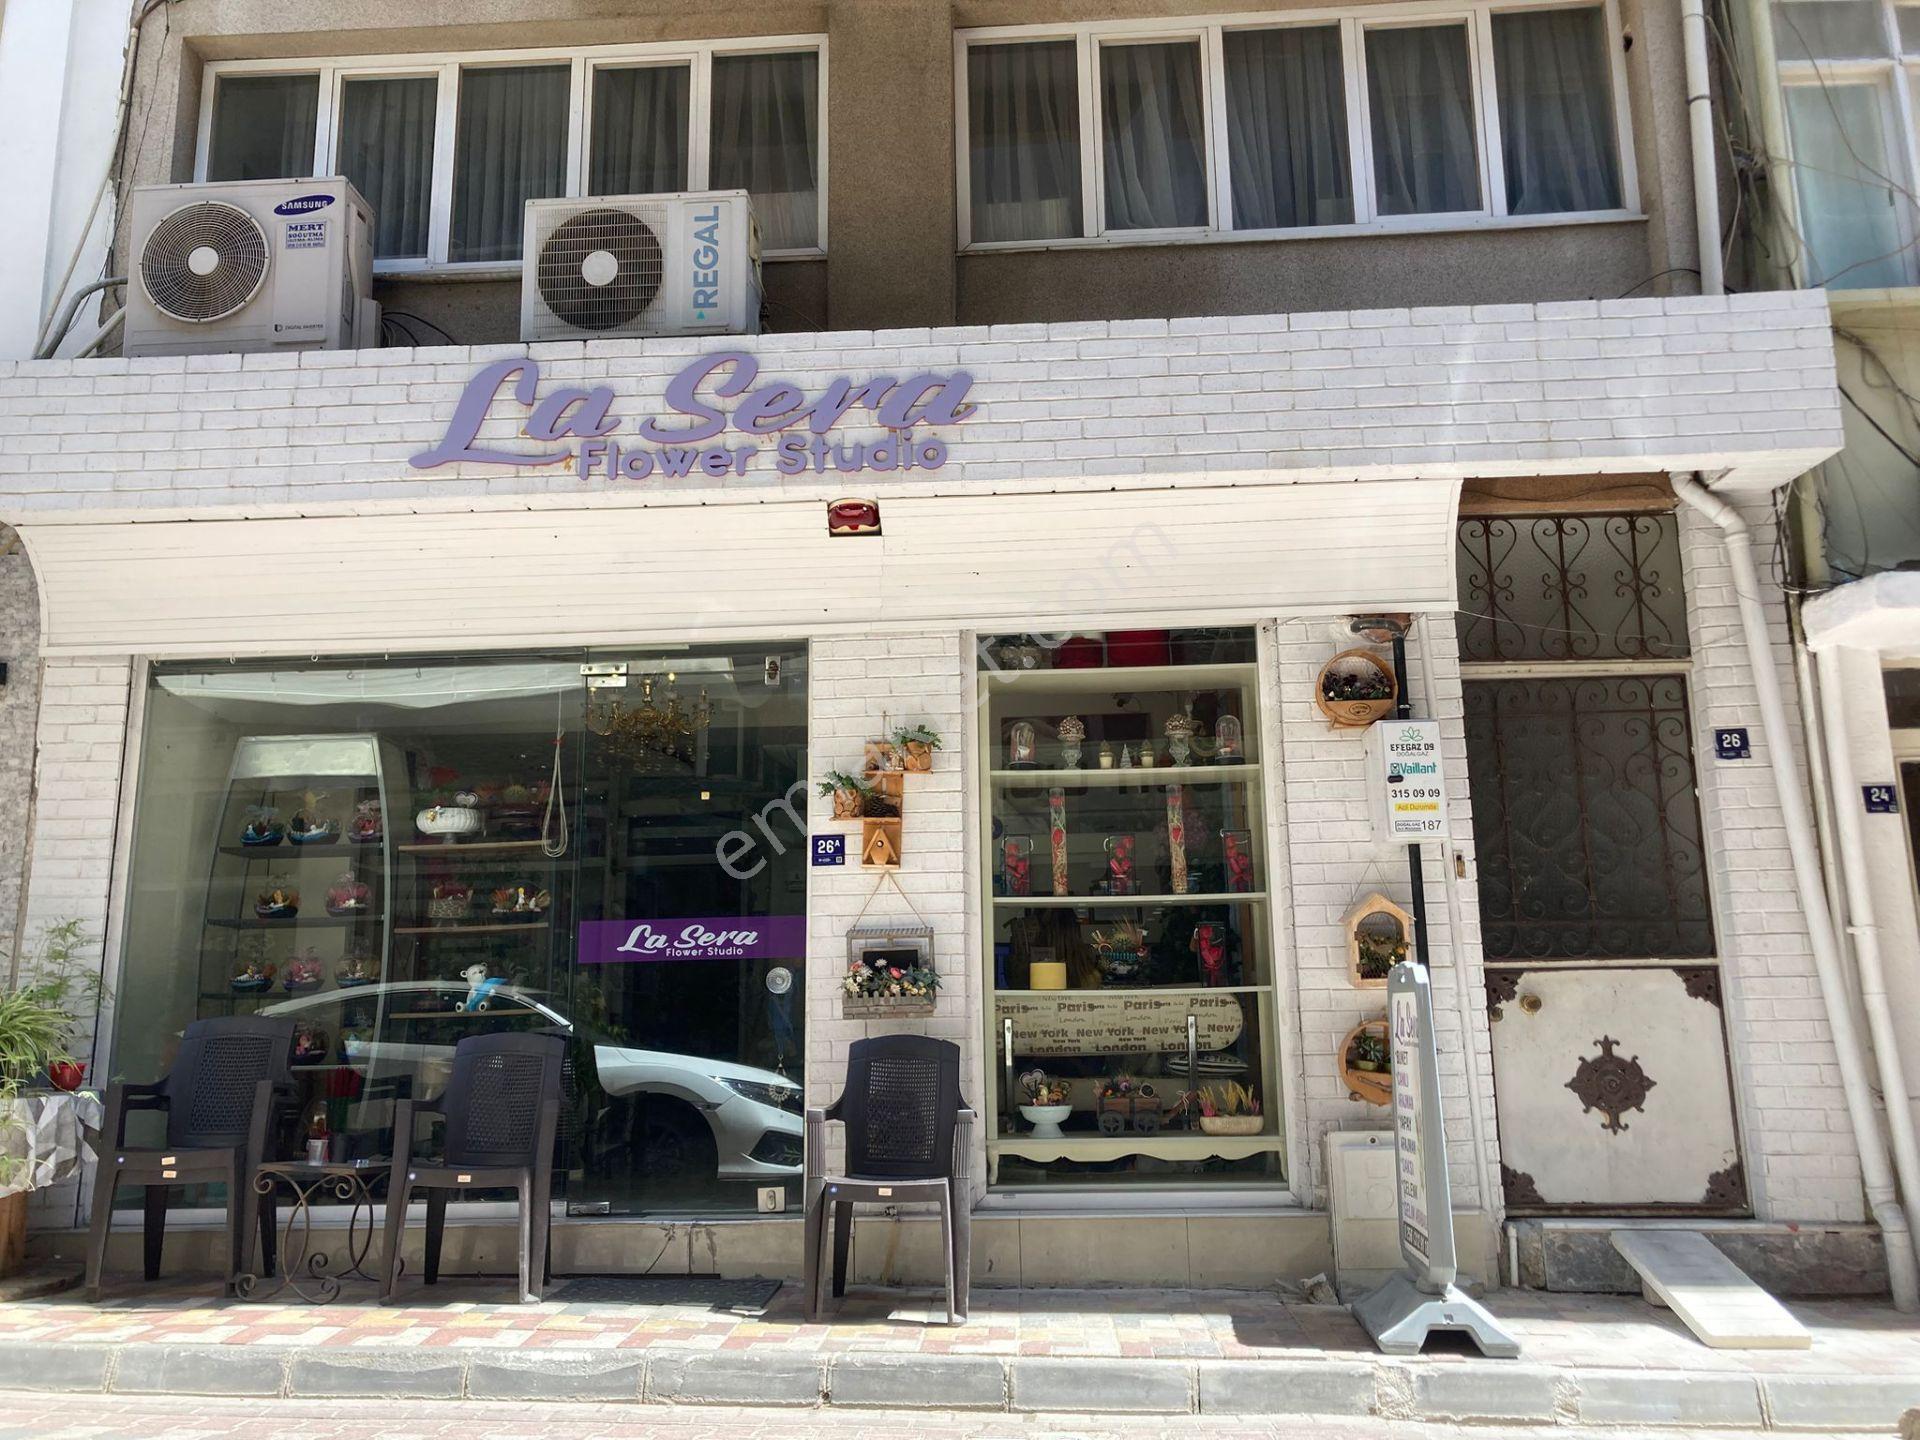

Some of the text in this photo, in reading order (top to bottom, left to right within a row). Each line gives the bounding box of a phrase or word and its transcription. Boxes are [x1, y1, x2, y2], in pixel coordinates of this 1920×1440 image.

[281, 200, 328, 210] SAMSUNG
[288, 223, 324, 231] MERT
[692, 205, 720, 310] REGAL
[408, 351, 978, 469] La Sera
[579, 428, 948, 481] Flower Studio
[1390, 743, 1435, 752] EFEGAZ 09
[1722, 733, 1741, 748] 26
[1400, 761, 1437, 774] Vaillant
[1391, 788, 1441, 798] 315 09 09
[1870, 787, 1890, 802] 24
[1421, 820, 1442, 831] 187
[617, 924, 758, 954] La Sera
[666, 946, 744, 957] Flower Studio
[1057, 1001, 1096, 1013] Paris
[1123, 999, 1162, 1011] Paris
[1189, 996, 1229, 1008] Paris
[1012, 1030, 1038, 1039] New
[1041, 1028, 1069, 1038] York
[1076, 1028, 1103, 1037] New
[1107, 1026, 1135, 1036] York
[1142, 1025, 1169, 1035] New
[1207, 1023, 1235, 1033] New
[1096, 1042, 1147, 1052] London
[1161, 1041, 1212, 1051] Lonon
